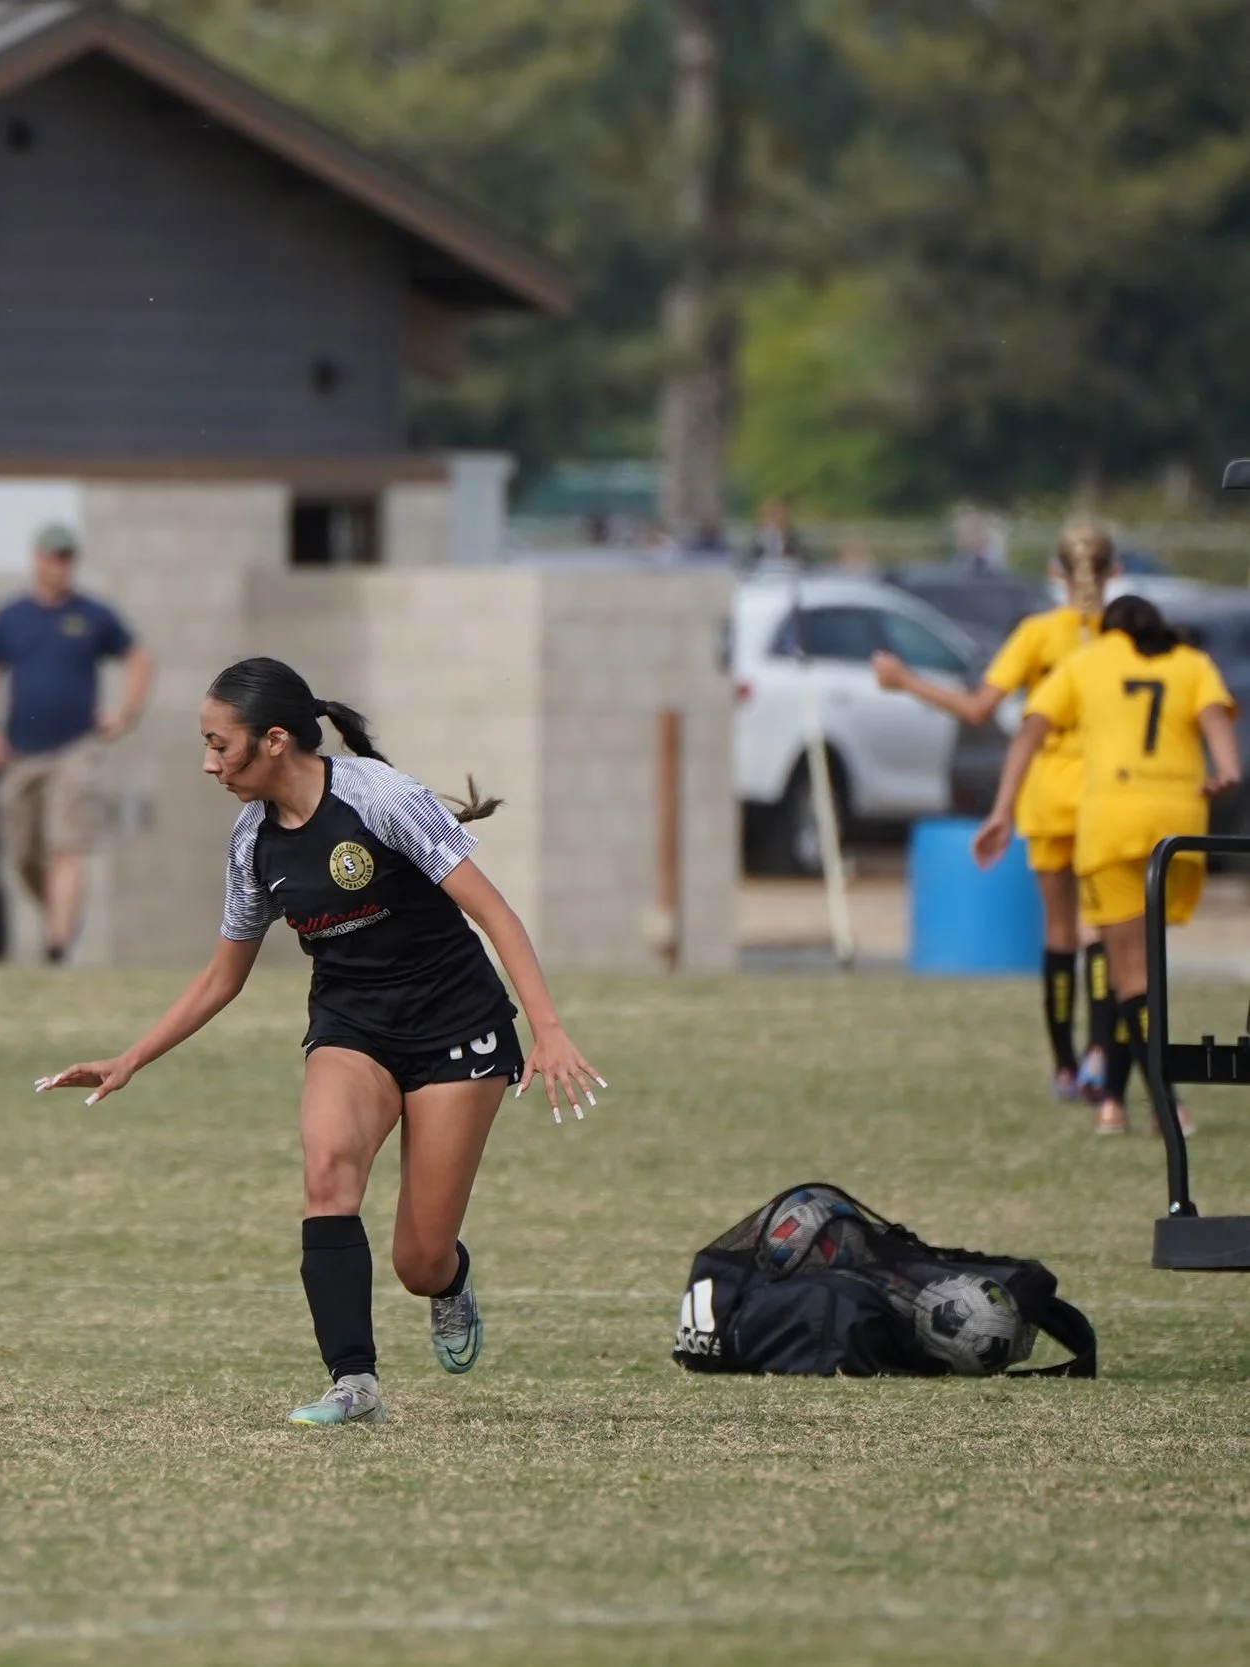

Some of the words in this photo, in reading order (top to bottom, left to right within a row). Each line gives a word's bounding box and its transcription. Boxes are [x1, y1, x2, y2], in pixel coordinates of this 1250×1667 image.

[1123, 678, 1165, 757] 7
[345, 843, 362, 854] ELITE
[334, 874, 365, 889] FOOTBALL
[363, 864, 373, 882] CLUB
